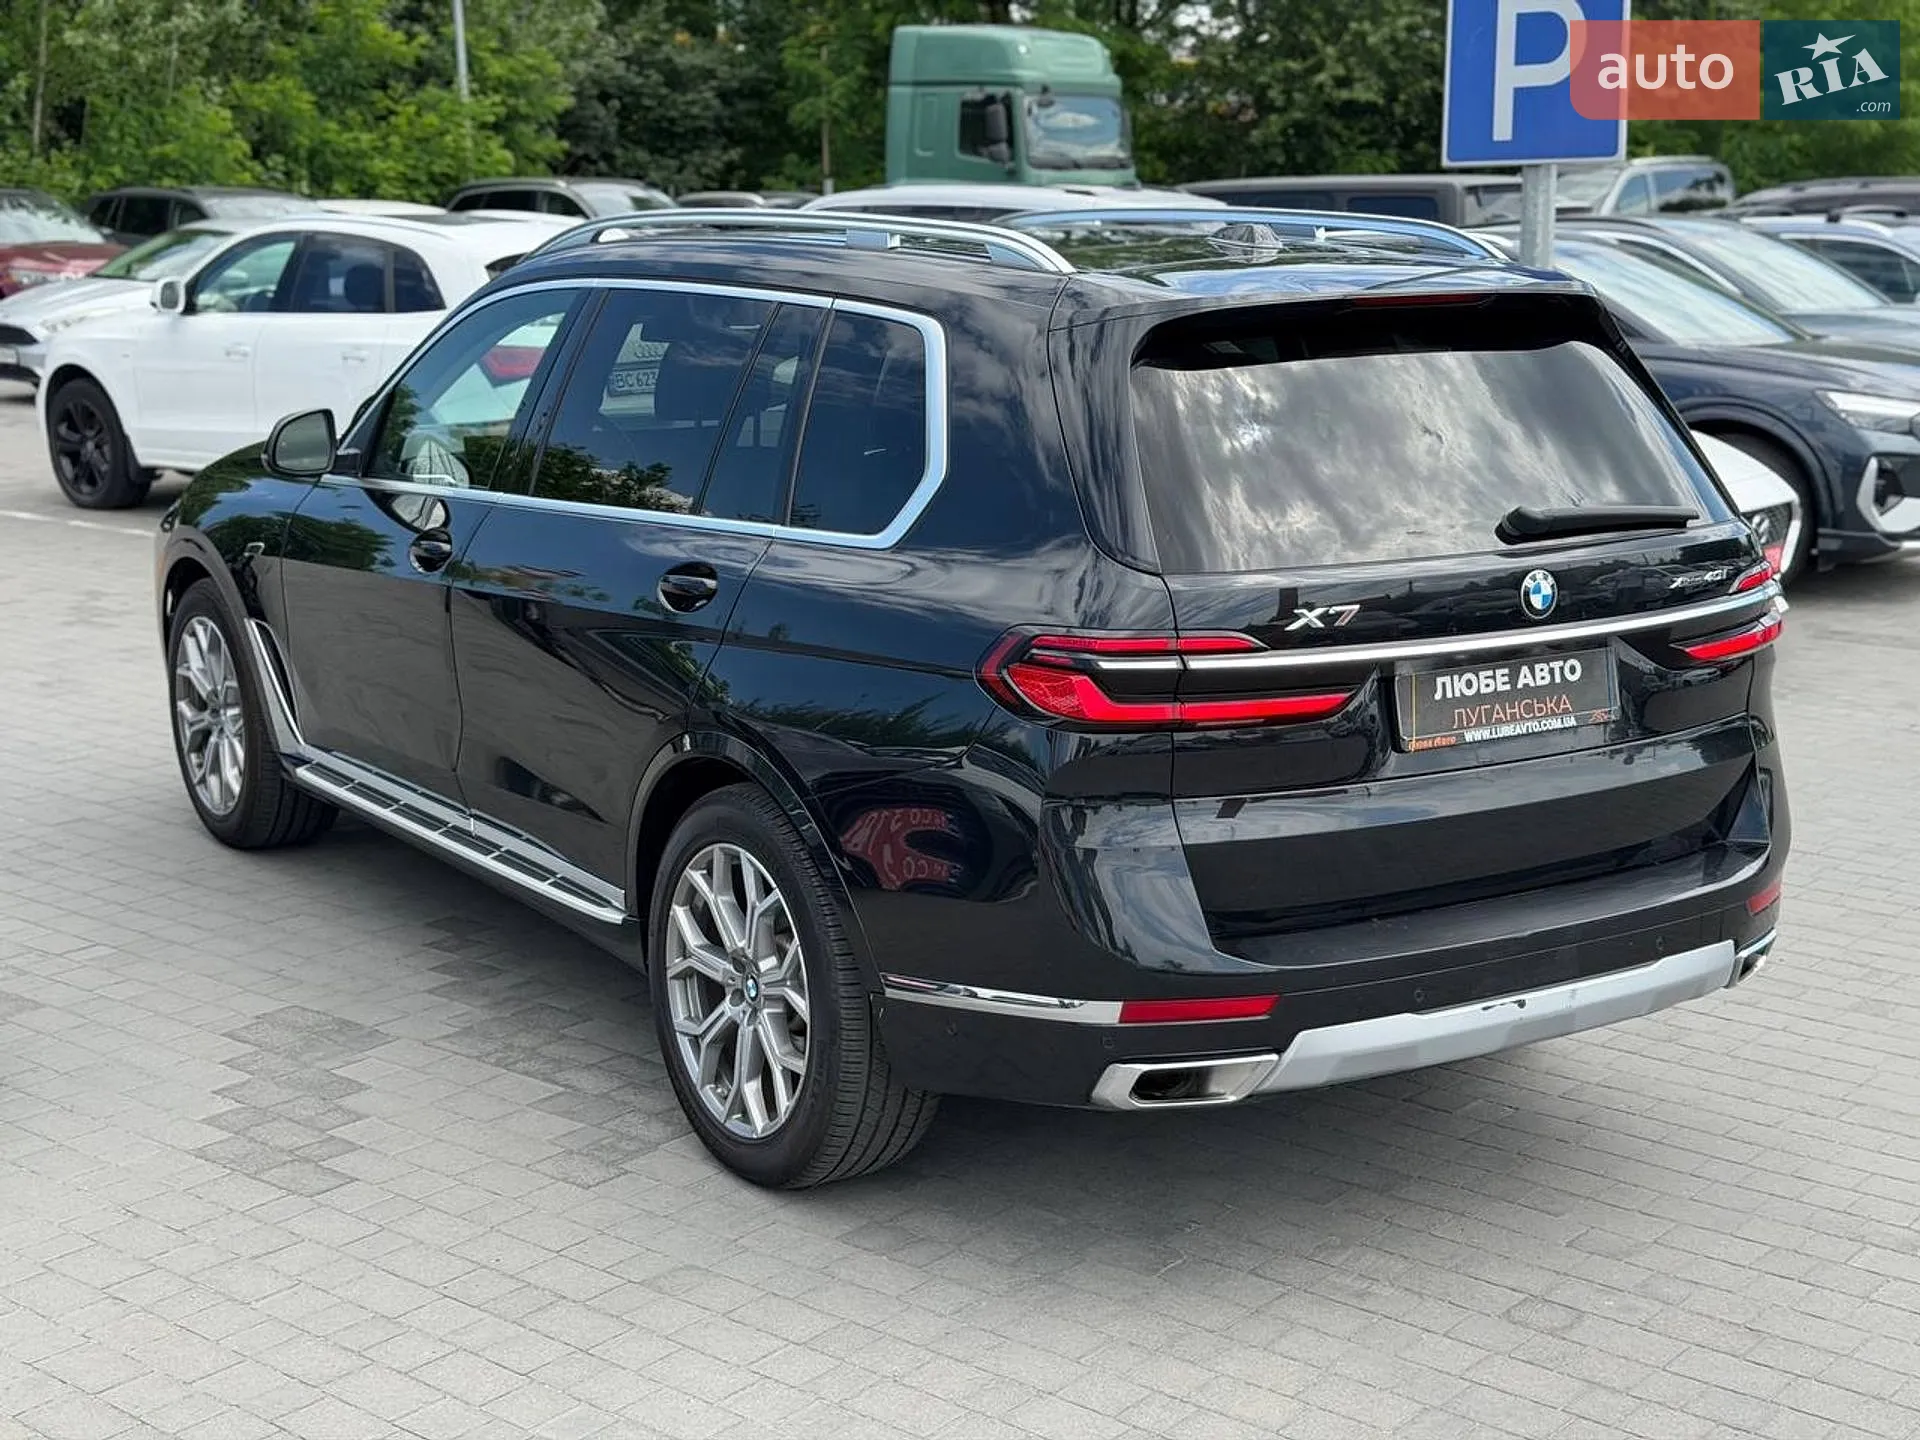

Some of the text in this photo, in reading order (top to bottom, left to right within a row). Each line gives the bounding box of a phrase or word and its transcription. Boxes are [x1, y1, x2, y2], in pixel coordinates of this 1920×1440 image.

[1492, 0, 1587, 142] P
[1285, 604, 1361, 631] X7
[1434, 658, 1582, 700] ЛЮБЕ АВТО
[1452, 694, 1573, 729] ЛУГАНСЬКА
[1464, 716, 1577, 743] WWW.LUBEAVTO.COM.UA
